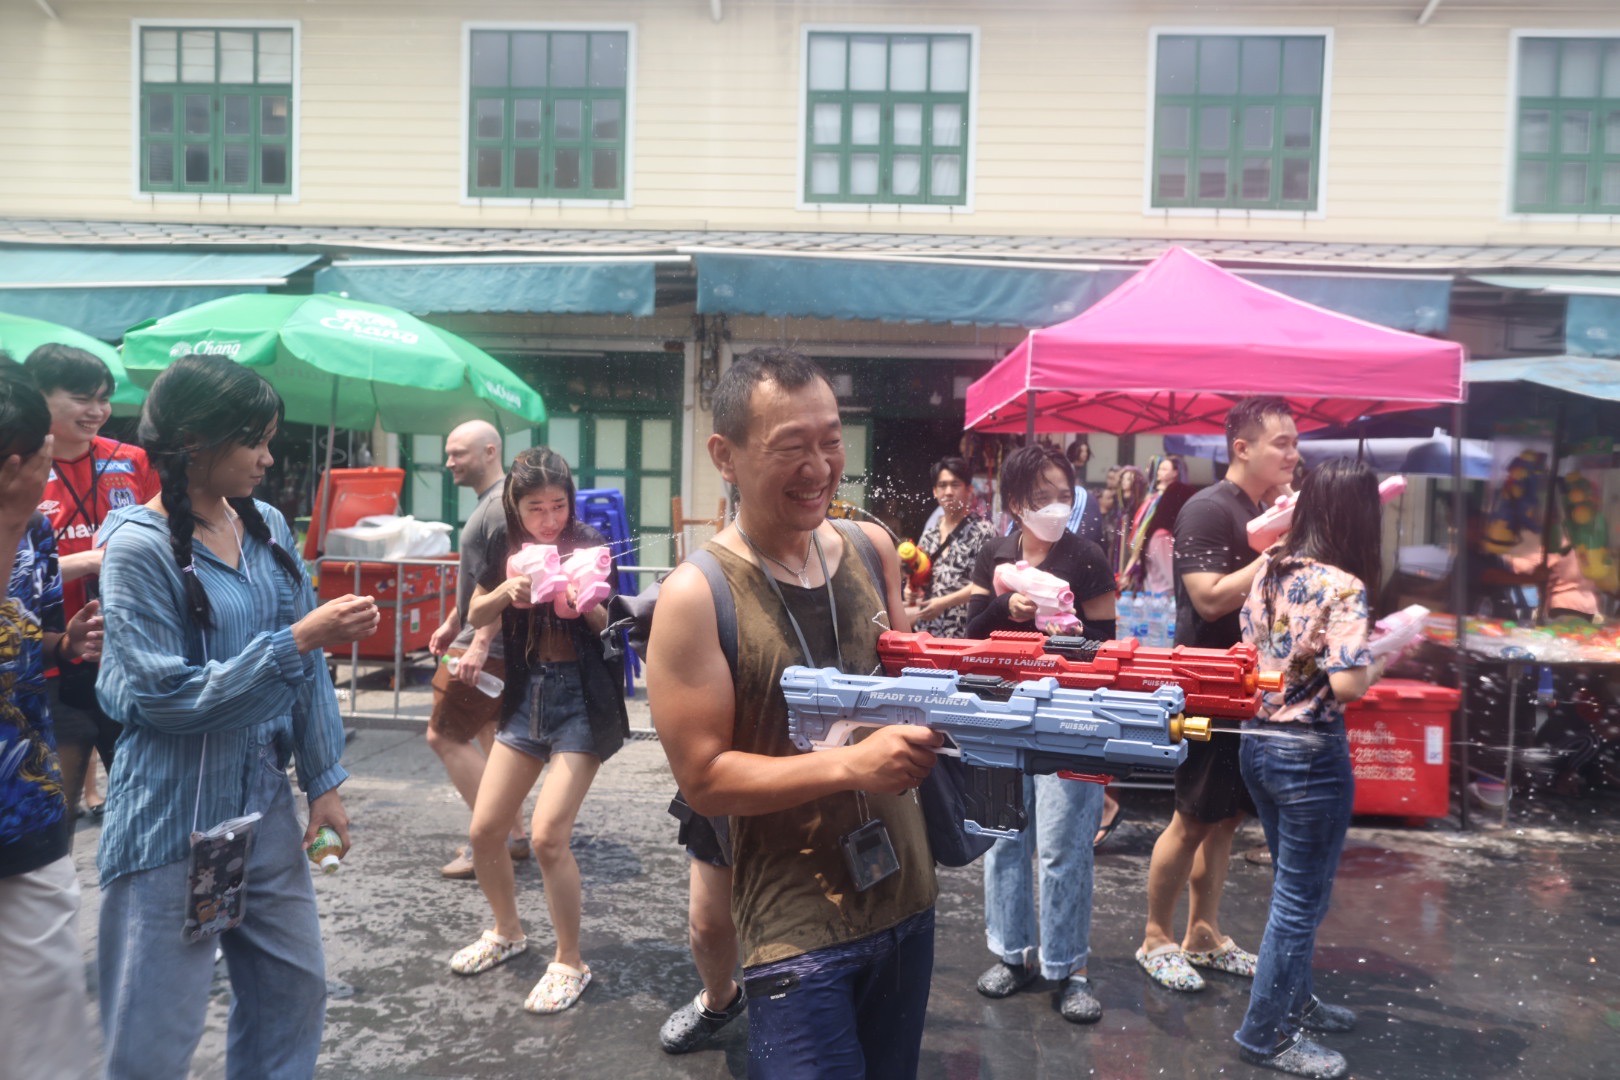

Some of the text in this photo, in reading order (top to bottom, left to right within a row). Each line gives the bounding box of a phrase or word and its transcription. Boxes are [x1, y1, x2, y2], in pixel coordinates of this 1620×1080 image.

[320, 317, 419, 345] Chang
[193, 340, 240, 359] Chang
[962, 655, 1057, 668] READY TO LAUNCH
[870, 691, 969, 707] READY TO LAUNCH
[1060, 721, 1099, 731] PUISSANT
